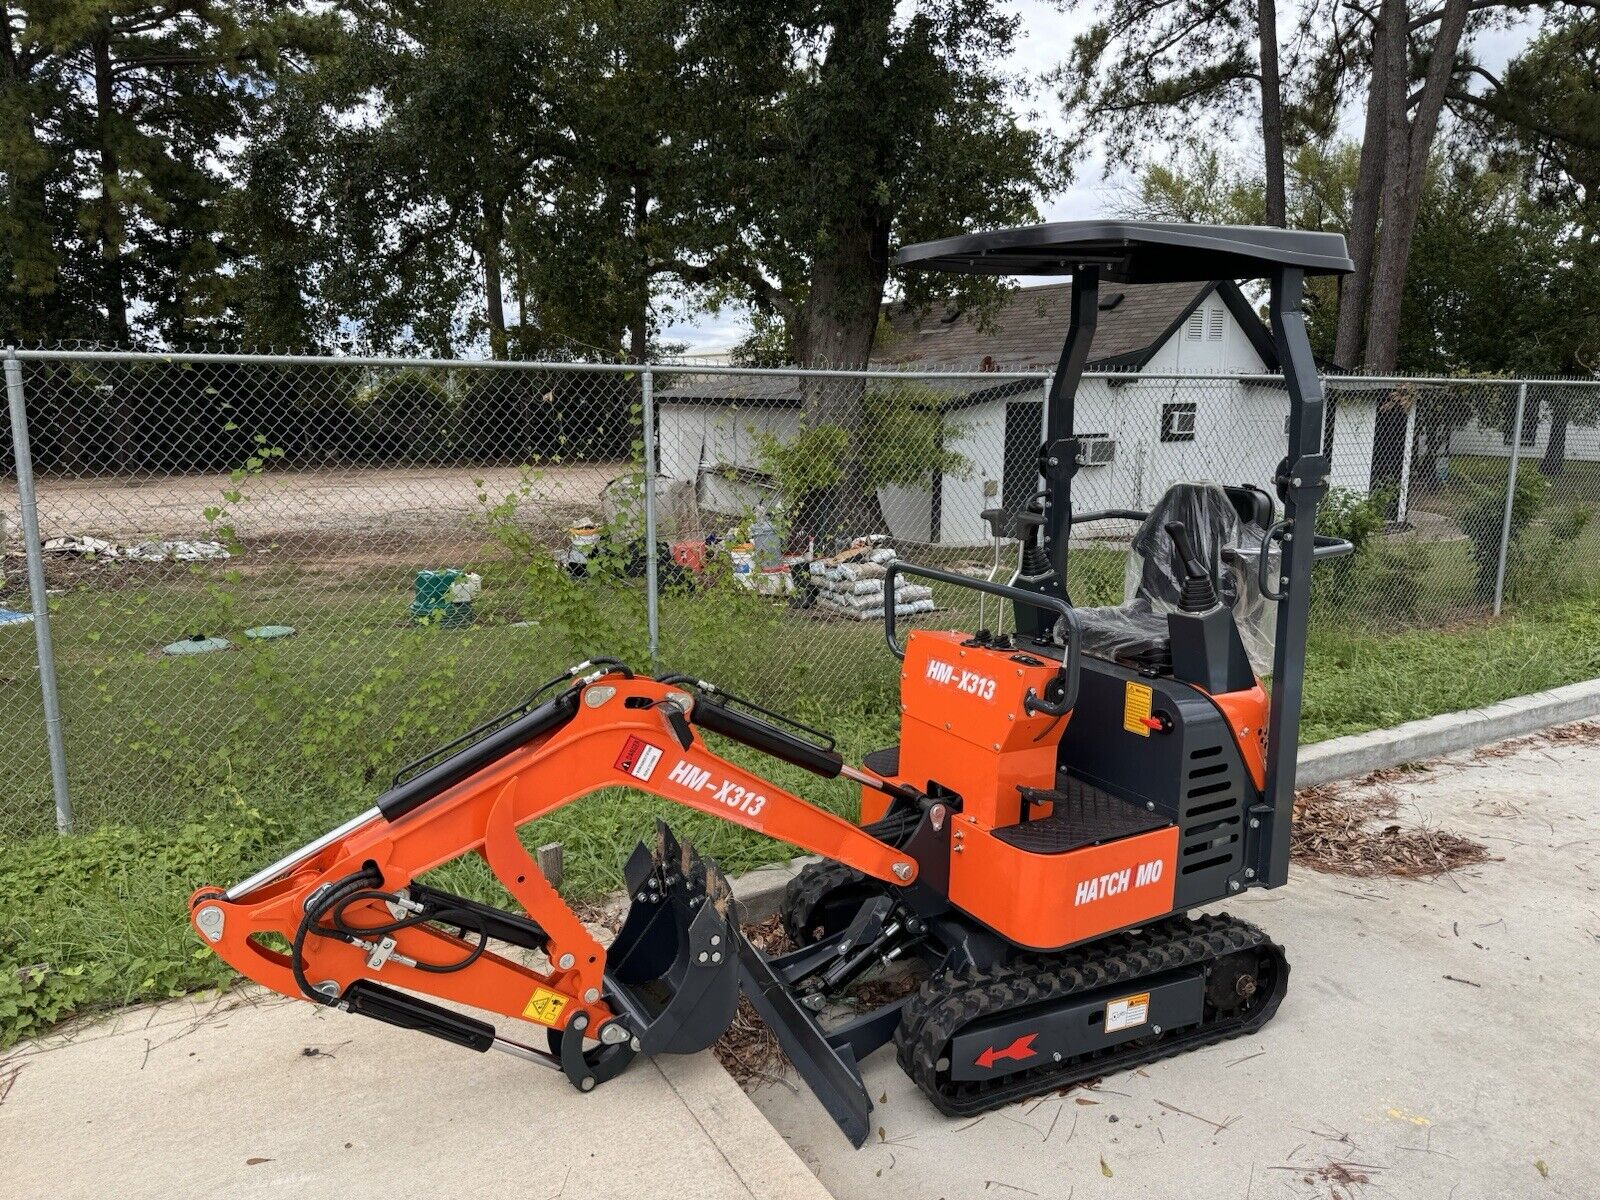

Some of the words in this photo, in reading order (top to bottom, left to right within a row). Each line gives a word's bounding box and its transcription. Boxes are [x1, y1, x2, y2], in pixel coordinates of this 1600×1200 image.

[927, 659, 996, 701] HM-X313
[668, 760, 766, 816] HM-X313
[1074, 868, 1131, 907] HATCH
